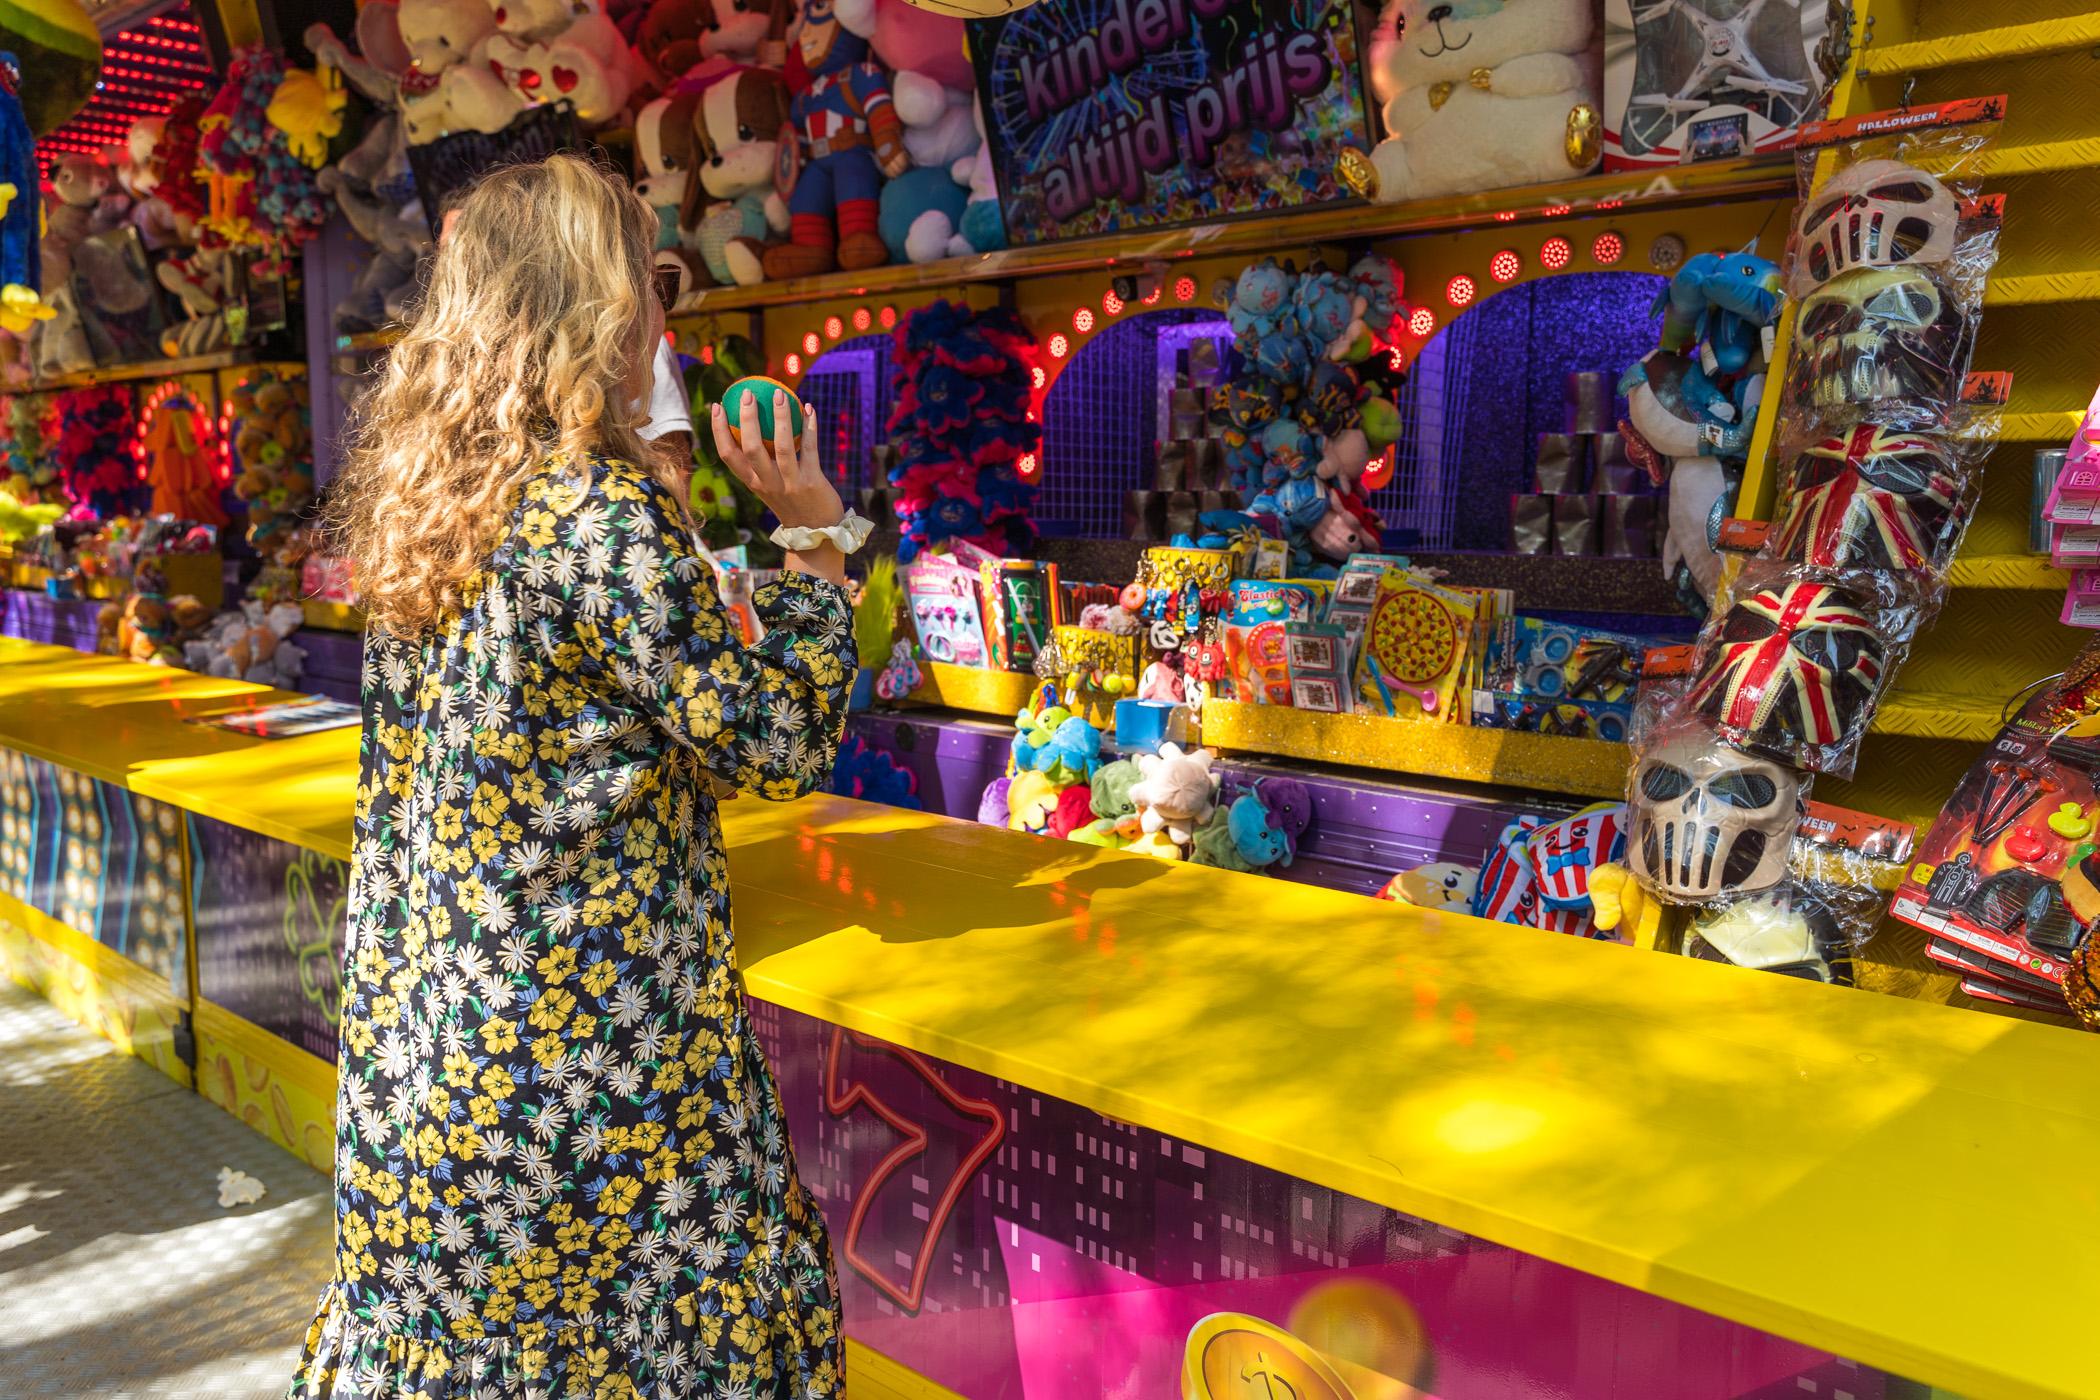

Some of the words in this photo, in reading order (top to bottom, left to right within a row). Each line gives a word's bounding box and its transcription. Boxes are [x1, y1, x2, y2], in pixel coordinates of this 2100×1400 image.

[1043, 94, 1173, 220] altijd
[1186, 30, 1326, 168] prijs
[1856, 111, 1937, 132] HALLOWEEN
[1797, 815, 1838, 833] WEEN
